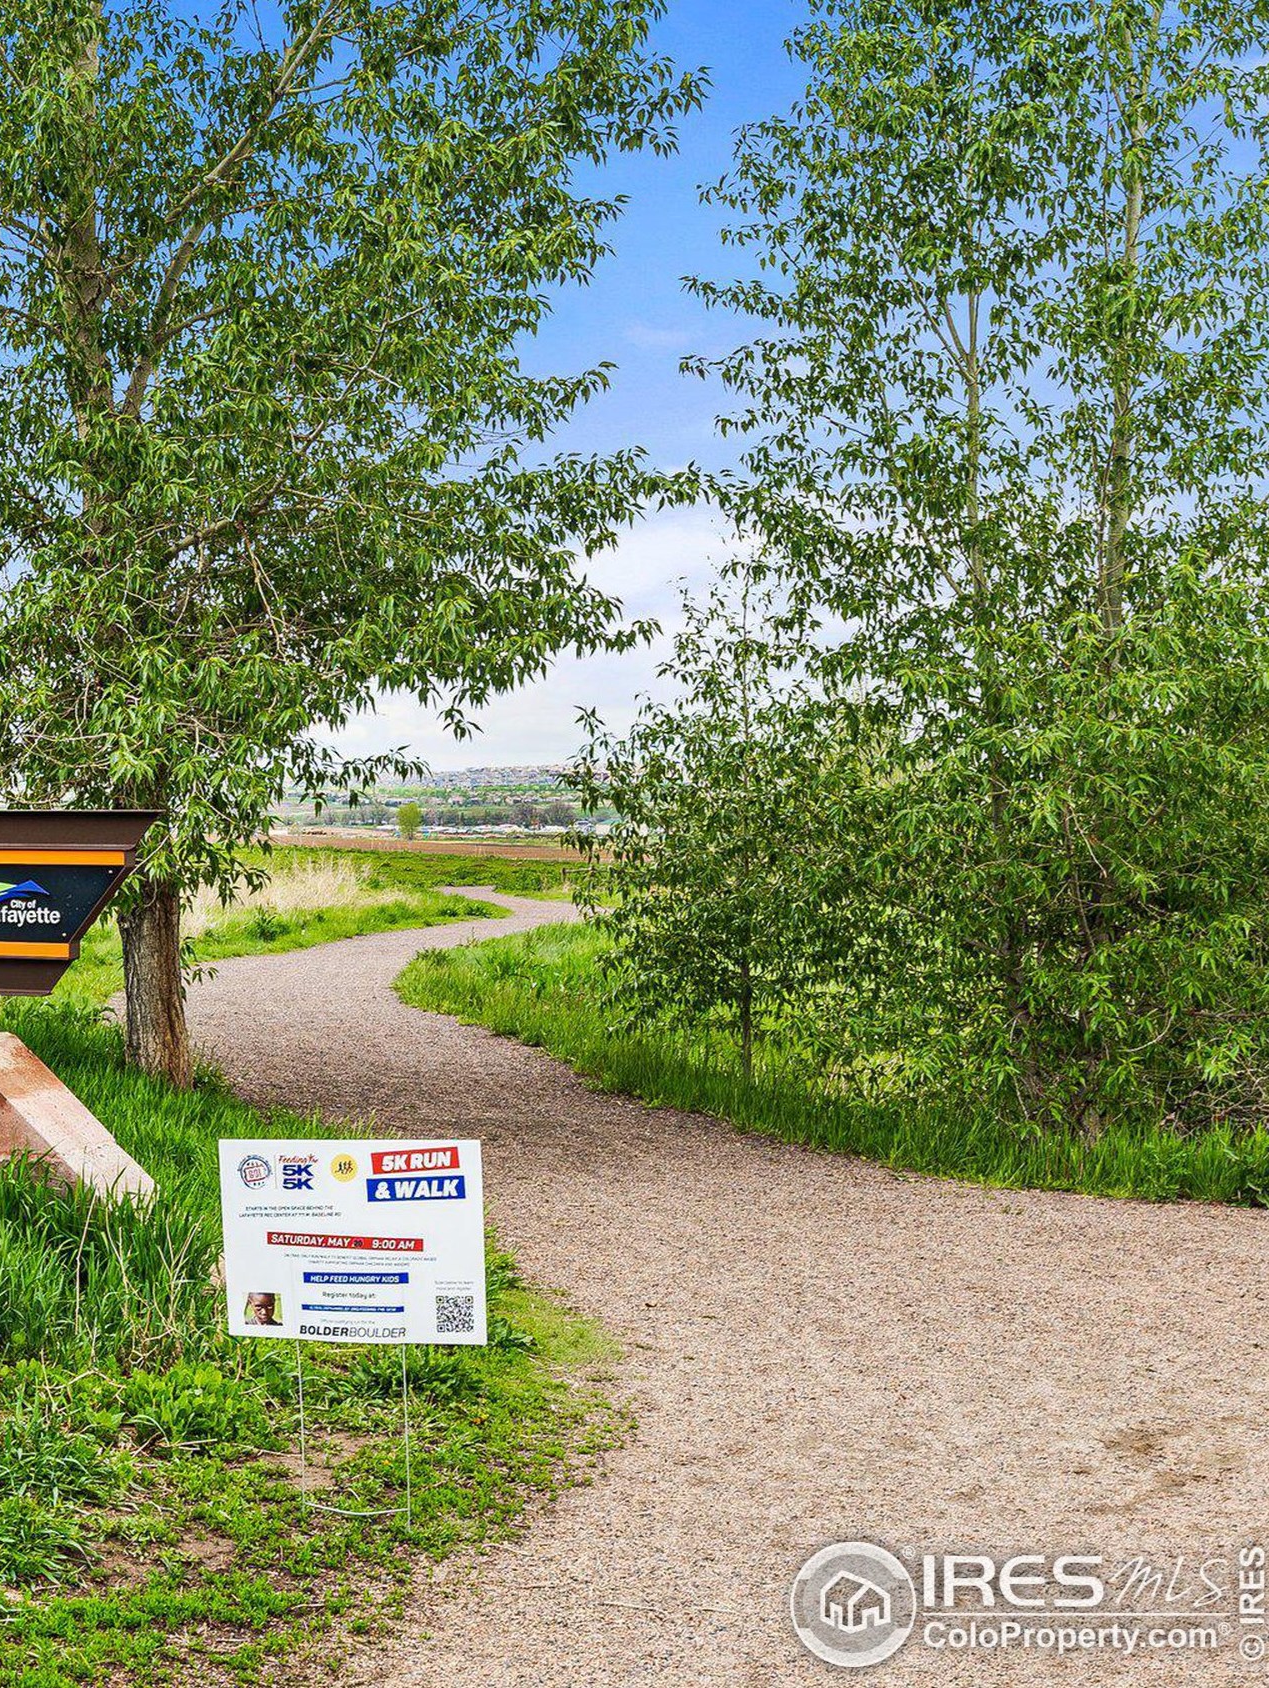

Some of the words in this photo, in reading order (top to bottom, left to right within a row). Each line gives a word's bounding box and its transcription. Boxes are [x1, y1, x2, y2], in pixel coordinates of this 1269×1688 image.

[10, 899, 26, 910] City
[27, 899, 37, 909] of
[381, 1153, 408, 1172] 5K
[409, 1150, 452, 1170] RUN
[282, 1164, 314, 1177] 5K
[282, 1177, 314, 1190] 5K
[374, 1181, 391, 1200] &
[394, 1178, 460, 1199] WALK
[271, 1232, 326, 1247] SATURDAY,
[327, 1236, 351, 1247] MAY
[372, 1239, 396, 1249] 9:00
[397, 1239, 416, 1250] AM
[329, 1275, 349, 1283] FEED
[349, 1275, 381, 1283] HUNGRY
[381, 1275, 400, 1283] KIDS
